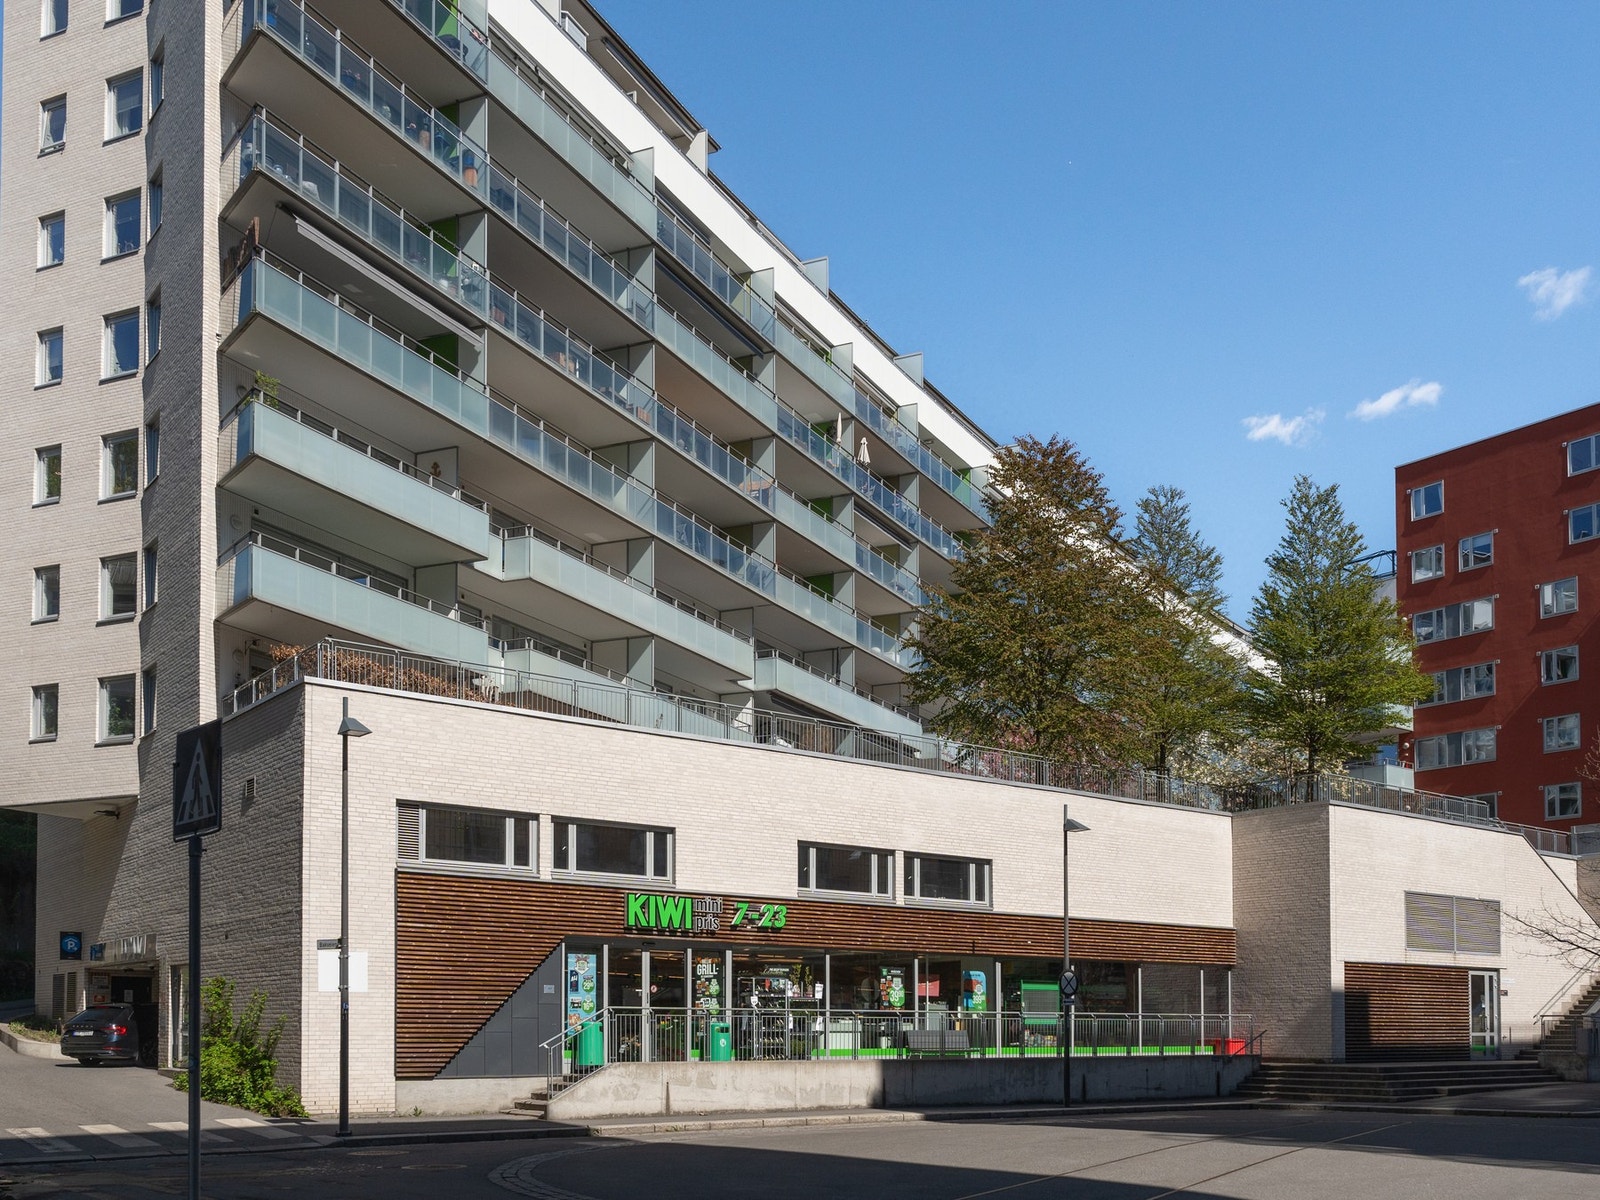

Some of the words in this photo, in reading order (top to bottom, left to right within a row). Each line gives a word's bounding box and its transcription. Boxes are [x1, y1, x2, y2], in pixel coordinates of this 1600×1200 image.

[626, 893, 693, 930] KIWI
[695, 896, 723, 914] mini
[695, 914, 720, 932] pris
